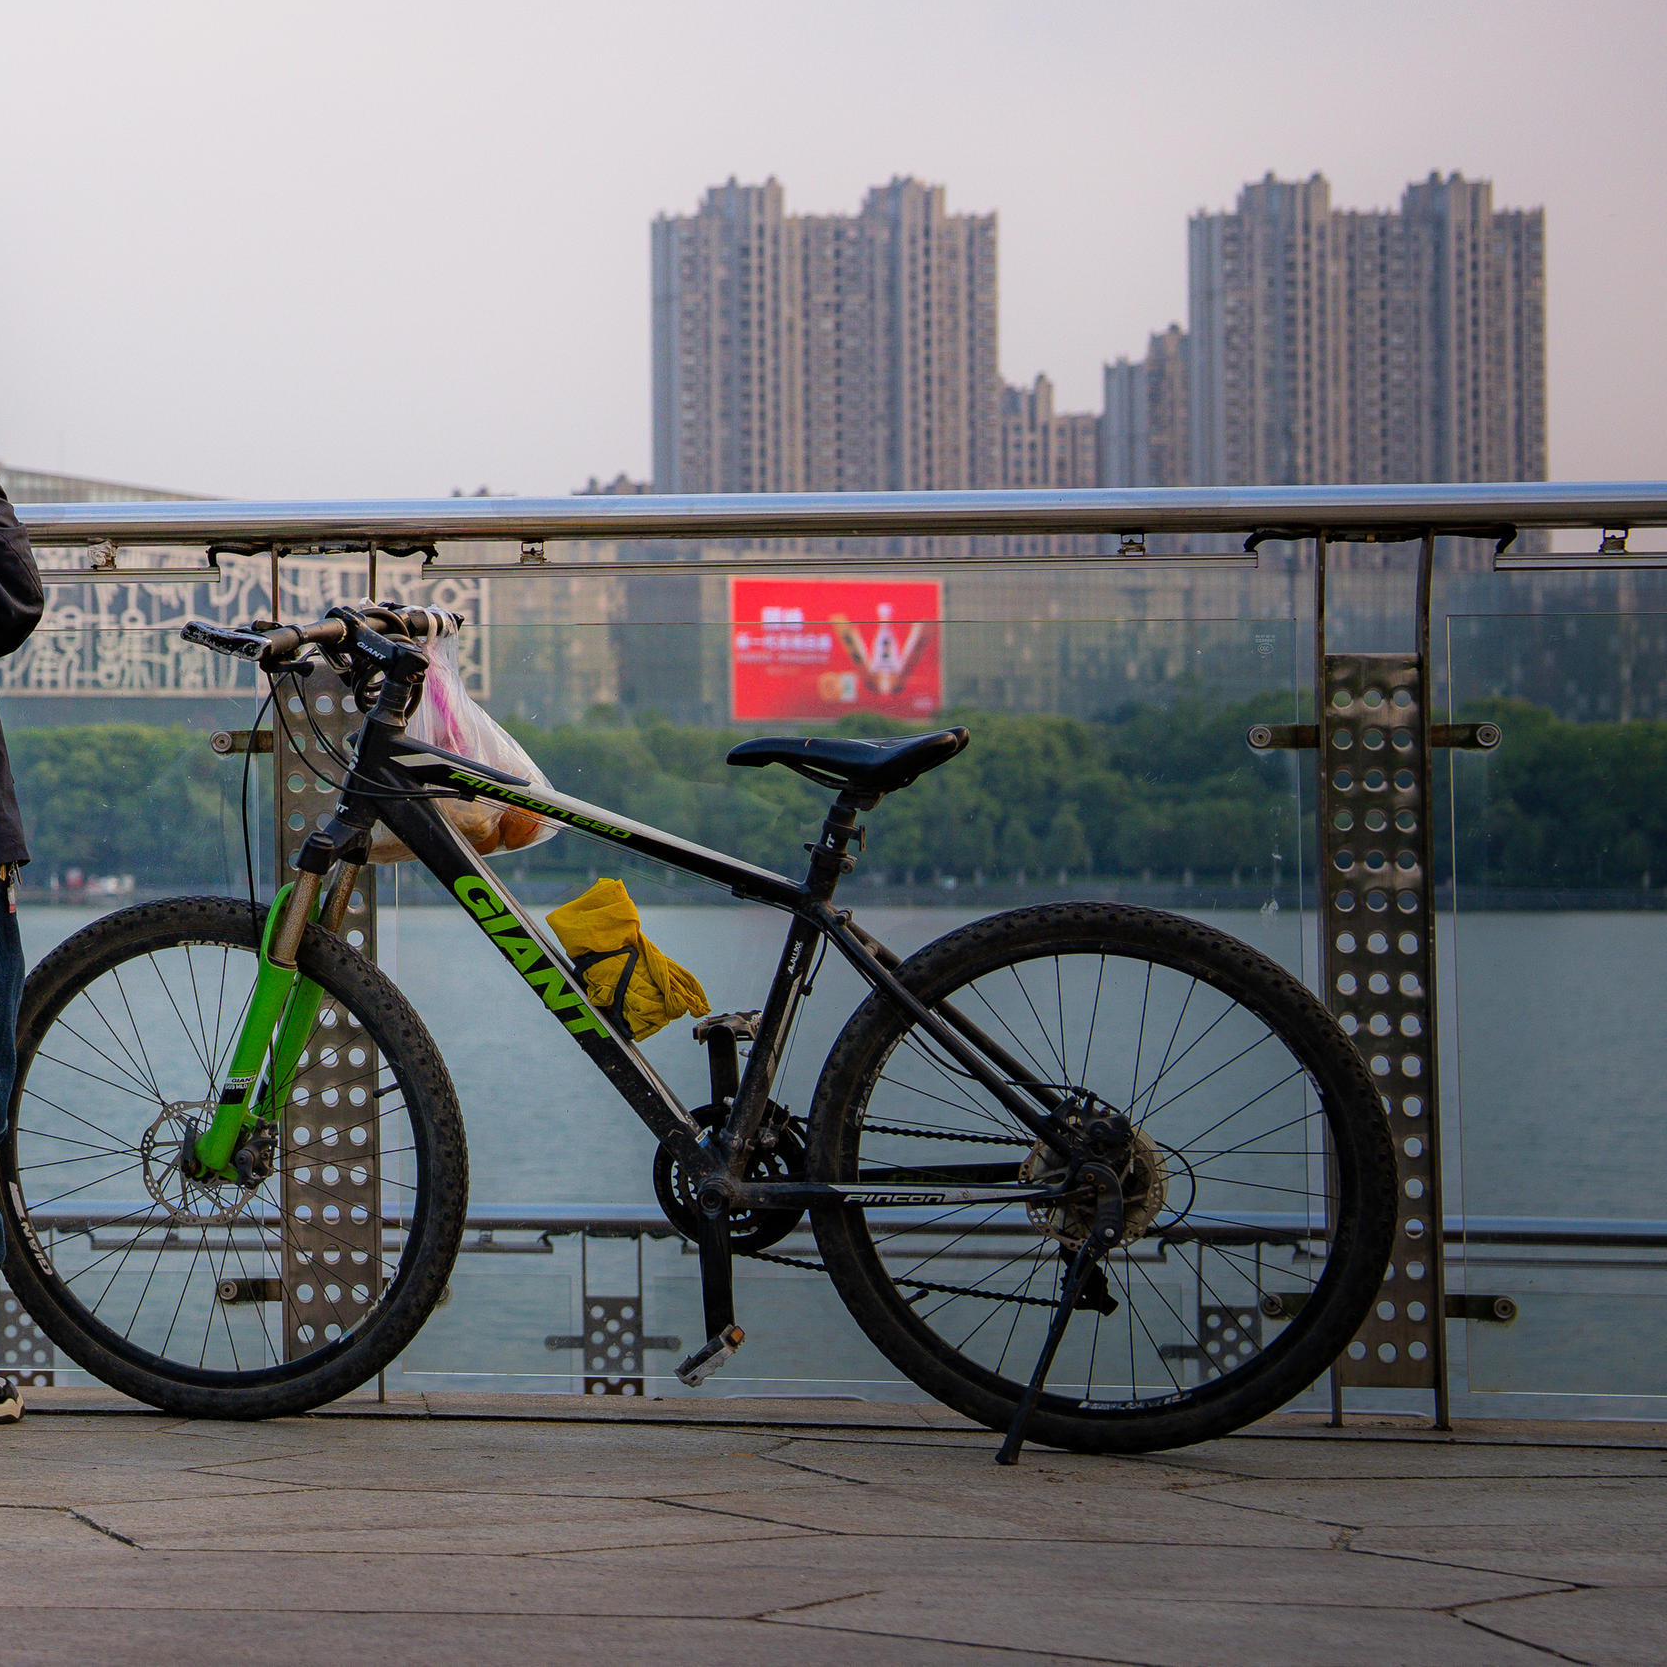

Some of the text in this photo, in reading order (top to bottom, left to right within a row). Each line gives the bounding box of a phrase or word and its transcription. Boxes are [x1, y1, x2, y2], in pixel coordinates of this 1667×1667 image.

[357, 641, 386, 660] GIANT
[571, 814, 632, 839] 680
[453, 875, 611, 1040] GIANT
